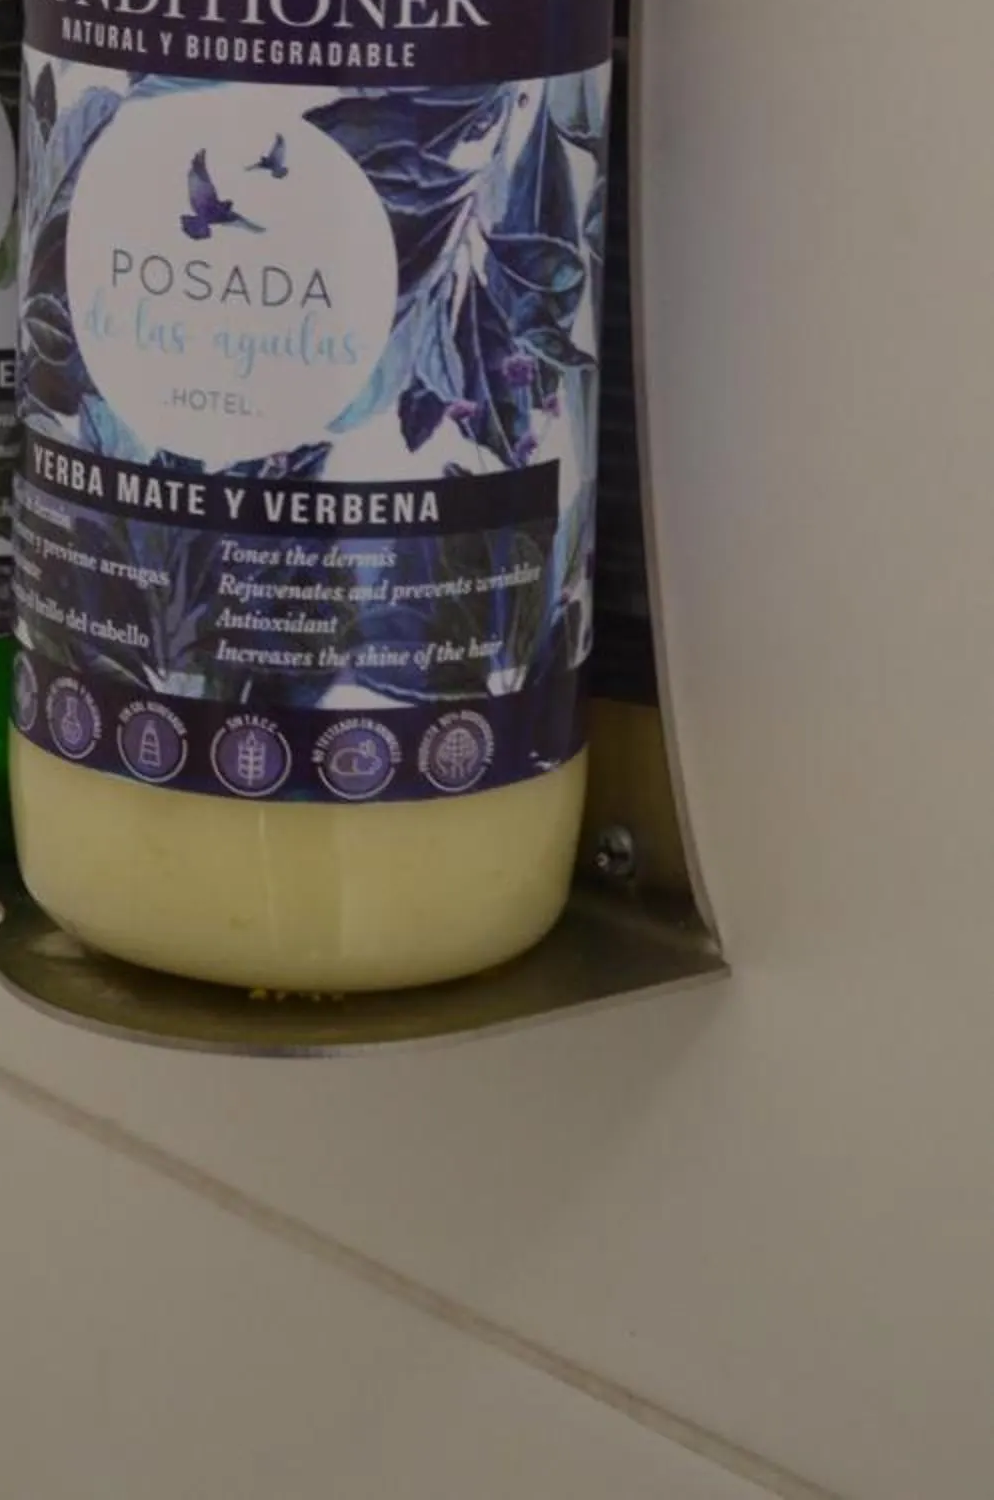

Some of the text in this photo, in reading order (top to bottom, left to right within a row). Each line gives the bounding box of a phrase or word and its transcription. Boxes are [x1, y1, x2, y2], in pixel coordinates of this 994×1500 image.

[61, 16, 416, 69] NATURAL Y BIODEGRADABLE
[112, 248, 333, 310] POSADA
[134, 296, 192, 355] las
[33, 443, 104, 497] YERBA
[117, 471, 206, 516] MATE
[223, 487, 246, 520] Y
[263, 490, 440, 526] VERBENA
[220, 538, 397, 568] Tones the dermis
[218, 572, 346, 603] Rejuvenates
[348, 580, 388, 602] and
[390, 575, 472, 608] prevents
[90, 619, 151, 649] cabello
[216, 606, 339, 634] Antioxidant
[216, 639, 313, 667] Increases
[317, 644, 350, 668] the
[356, 644, 410, 668] shine
[413, 641, 436, 671] of
[436, 638, 466, 663] the
